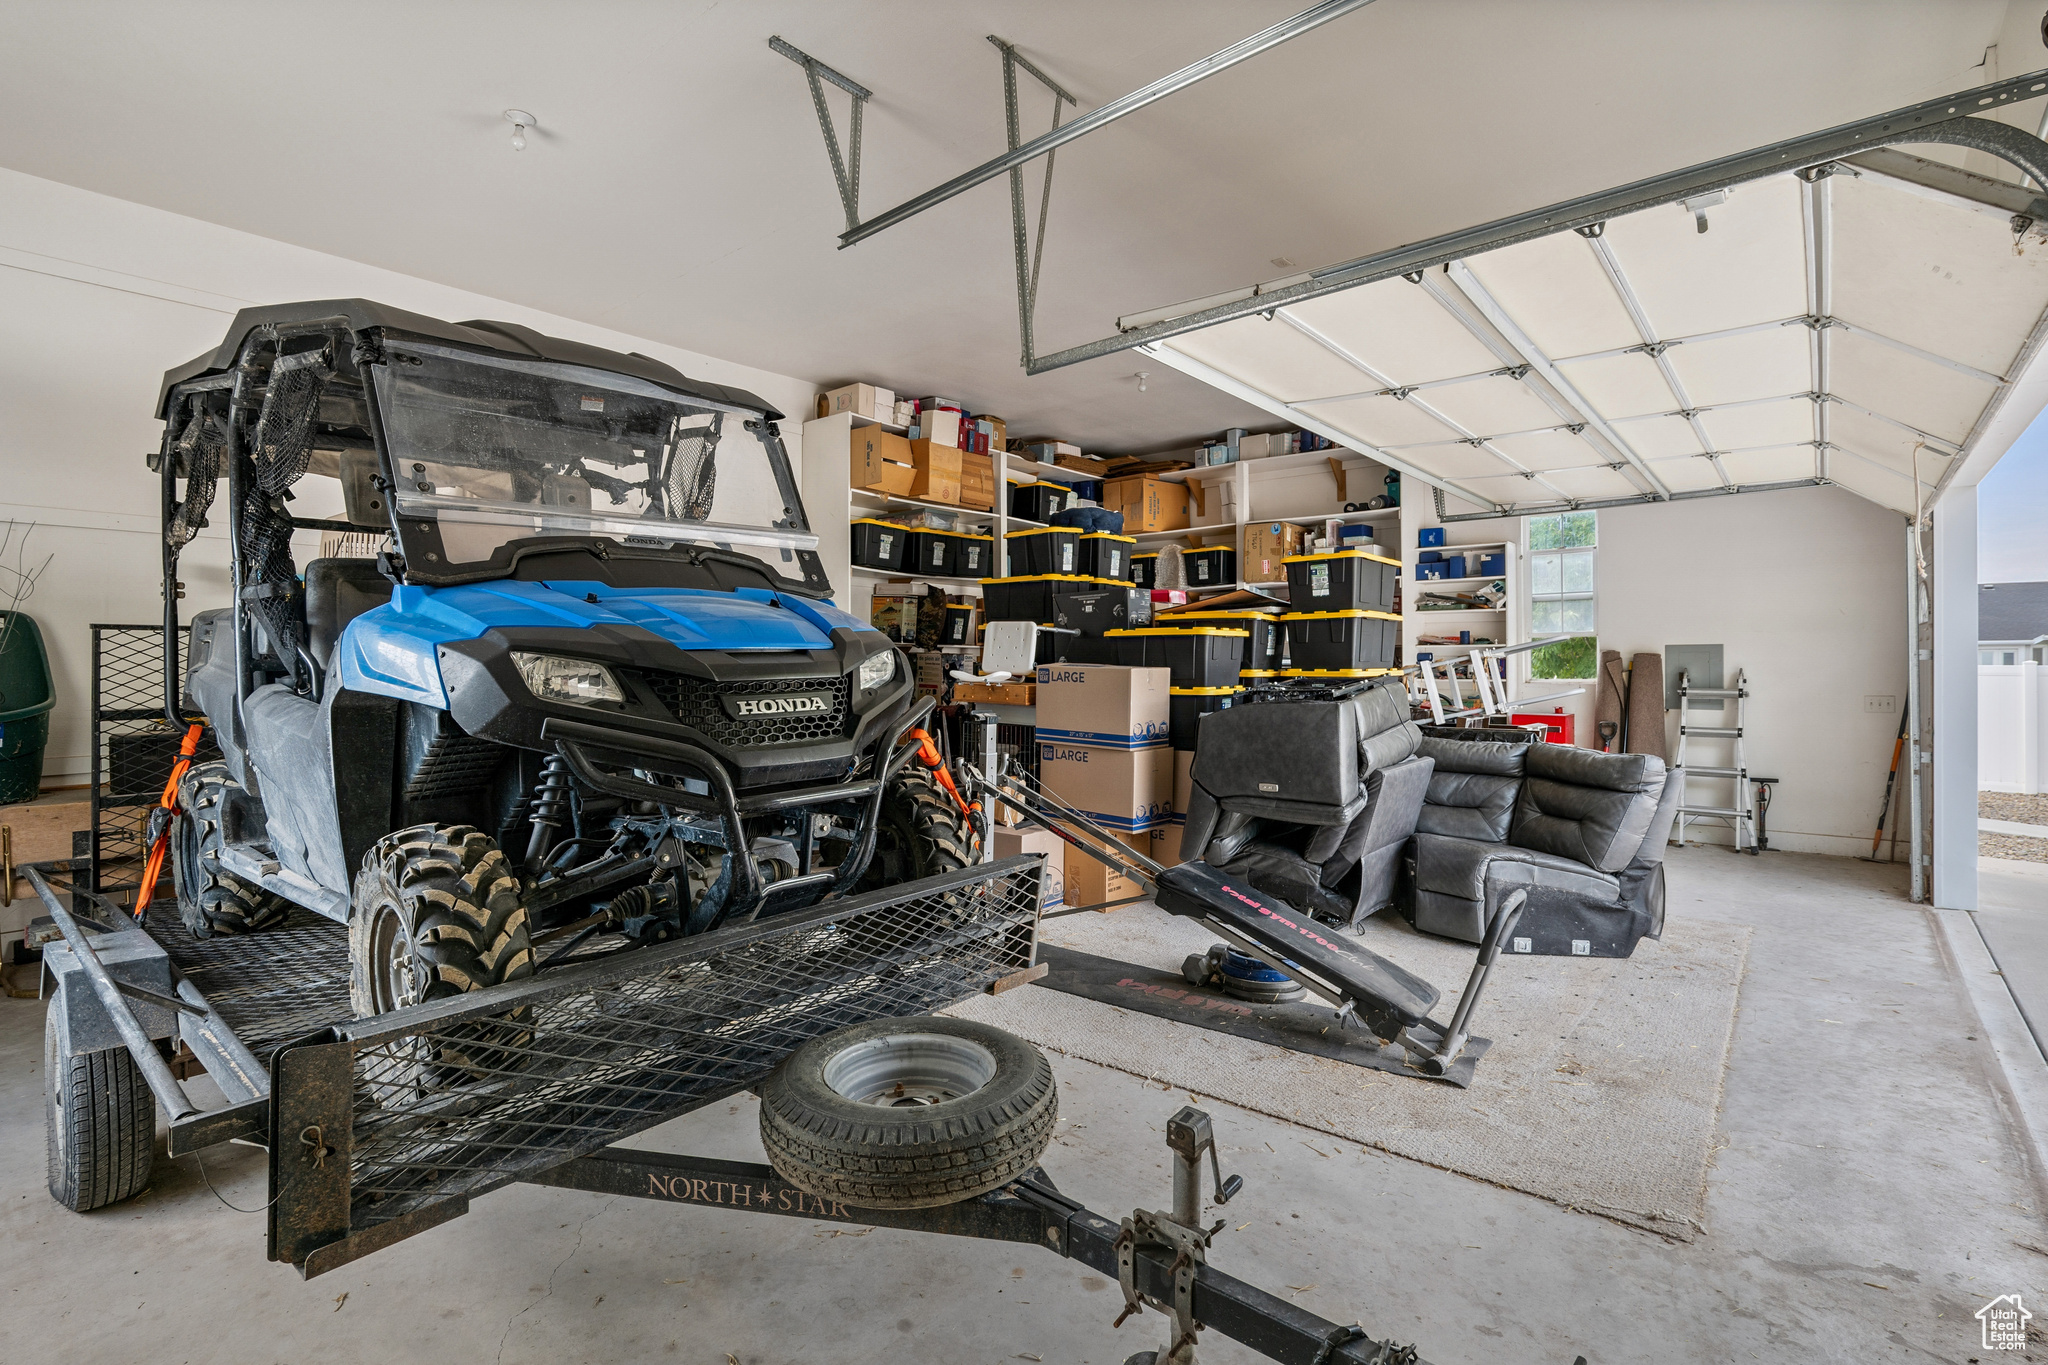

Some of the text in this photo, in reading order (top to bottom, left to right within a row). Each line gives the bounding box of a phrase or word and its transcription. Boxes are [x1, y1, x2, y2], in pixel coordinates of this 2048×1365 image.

[623, 537, 665, 546] HONDA
[1051, 671, 1085, 683] LARGE
[736, 697, 828, 715] HONDA
[1055, 748, 1089, 763] LARGE
[1221, 885, 1261, 909] total
[1258, 907, 1298, 930] gym
[1299, 927, 1339, 951] 1700
[1116, 978, 1253, 1016] total gym
[648, 1173, 852, 1218] NORTH STAR
